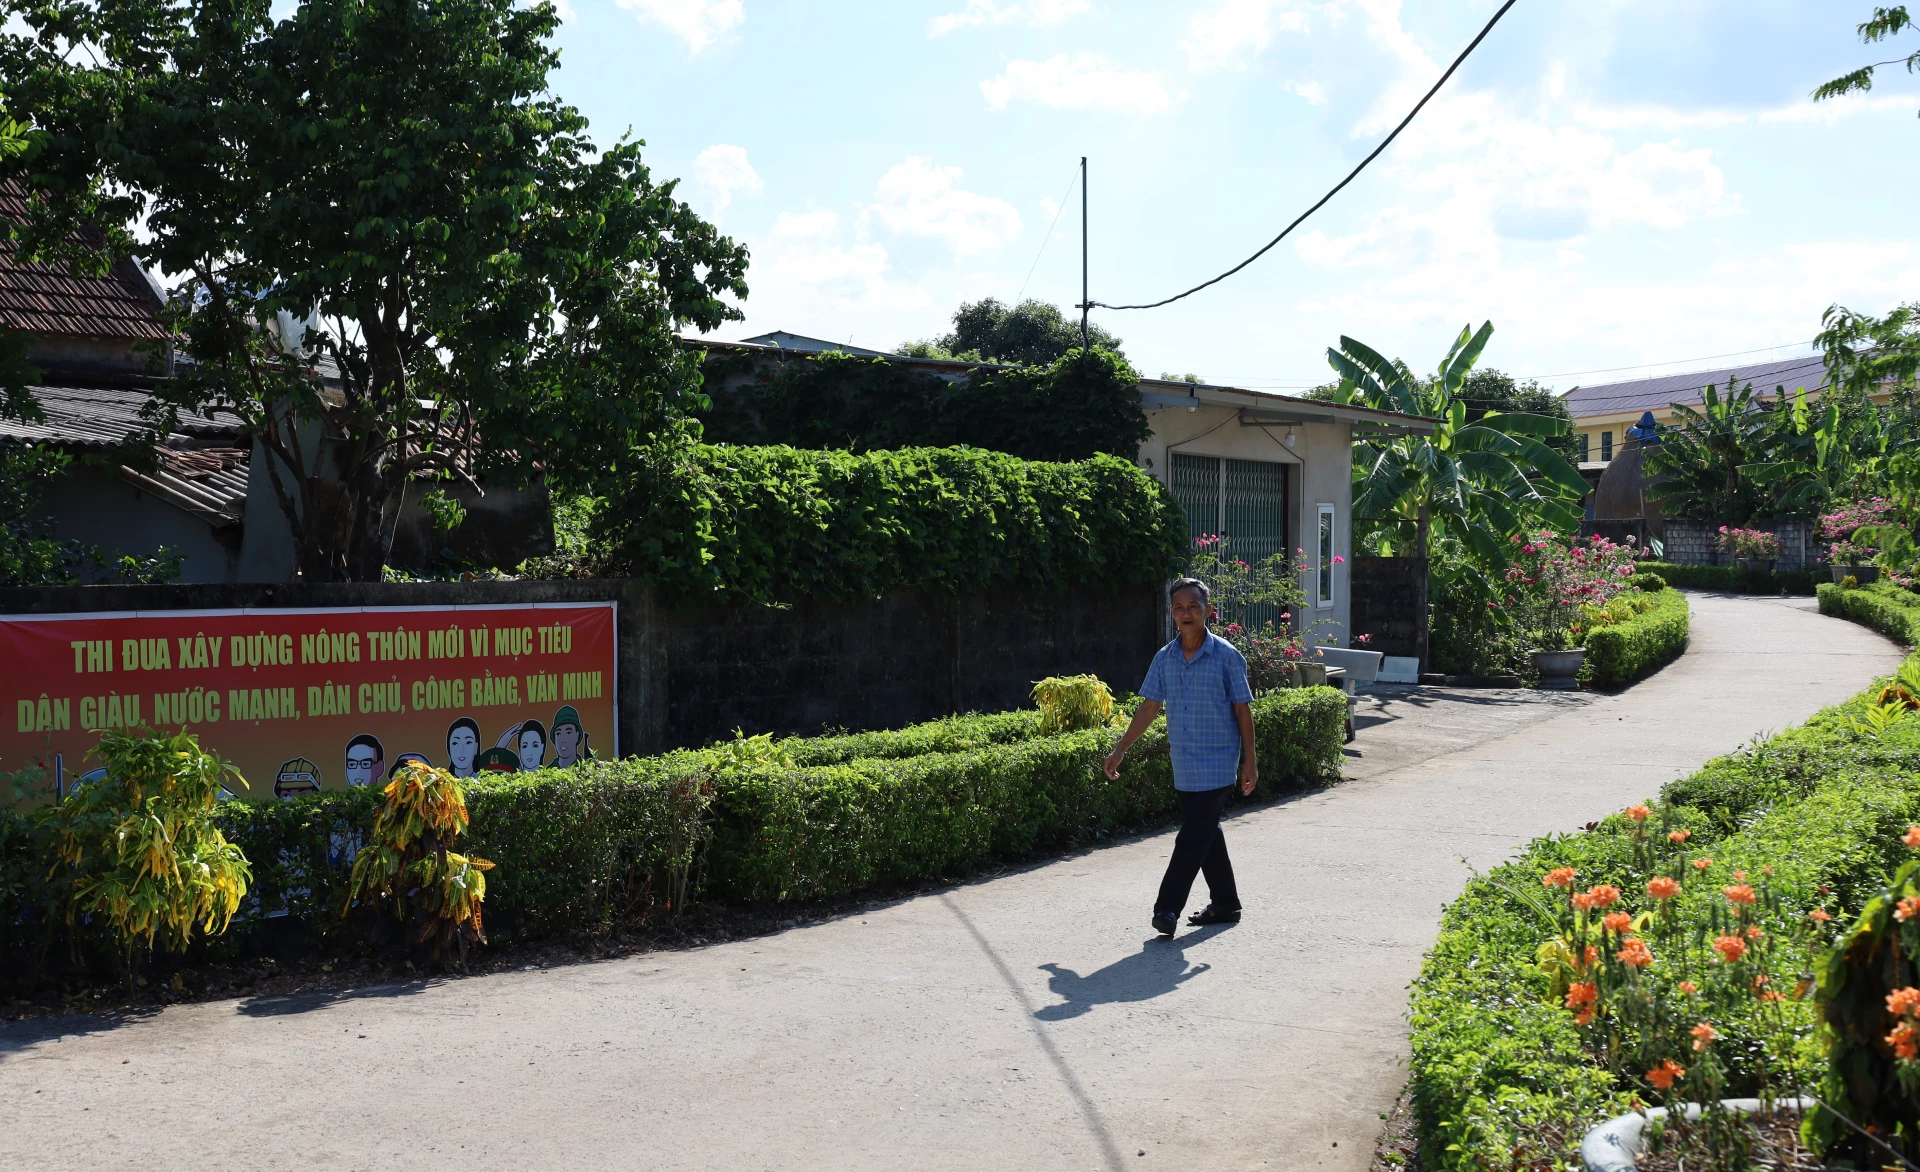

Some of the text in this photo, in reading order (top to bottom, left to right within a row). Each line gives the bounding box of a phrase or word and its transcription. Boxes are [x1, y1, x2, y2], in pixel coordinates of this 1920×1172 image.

[70, 621, 573, 673] THI ĐUA XÂY DỰNG NÔNG THÔN MỚI VÌ MỤC TIÊU
[17, 669, 602, 733] DÂN GIÀU, NƯỚC MẠNH, DÂN CHỦ, CÔNG BẰNG, VĂN MINH
